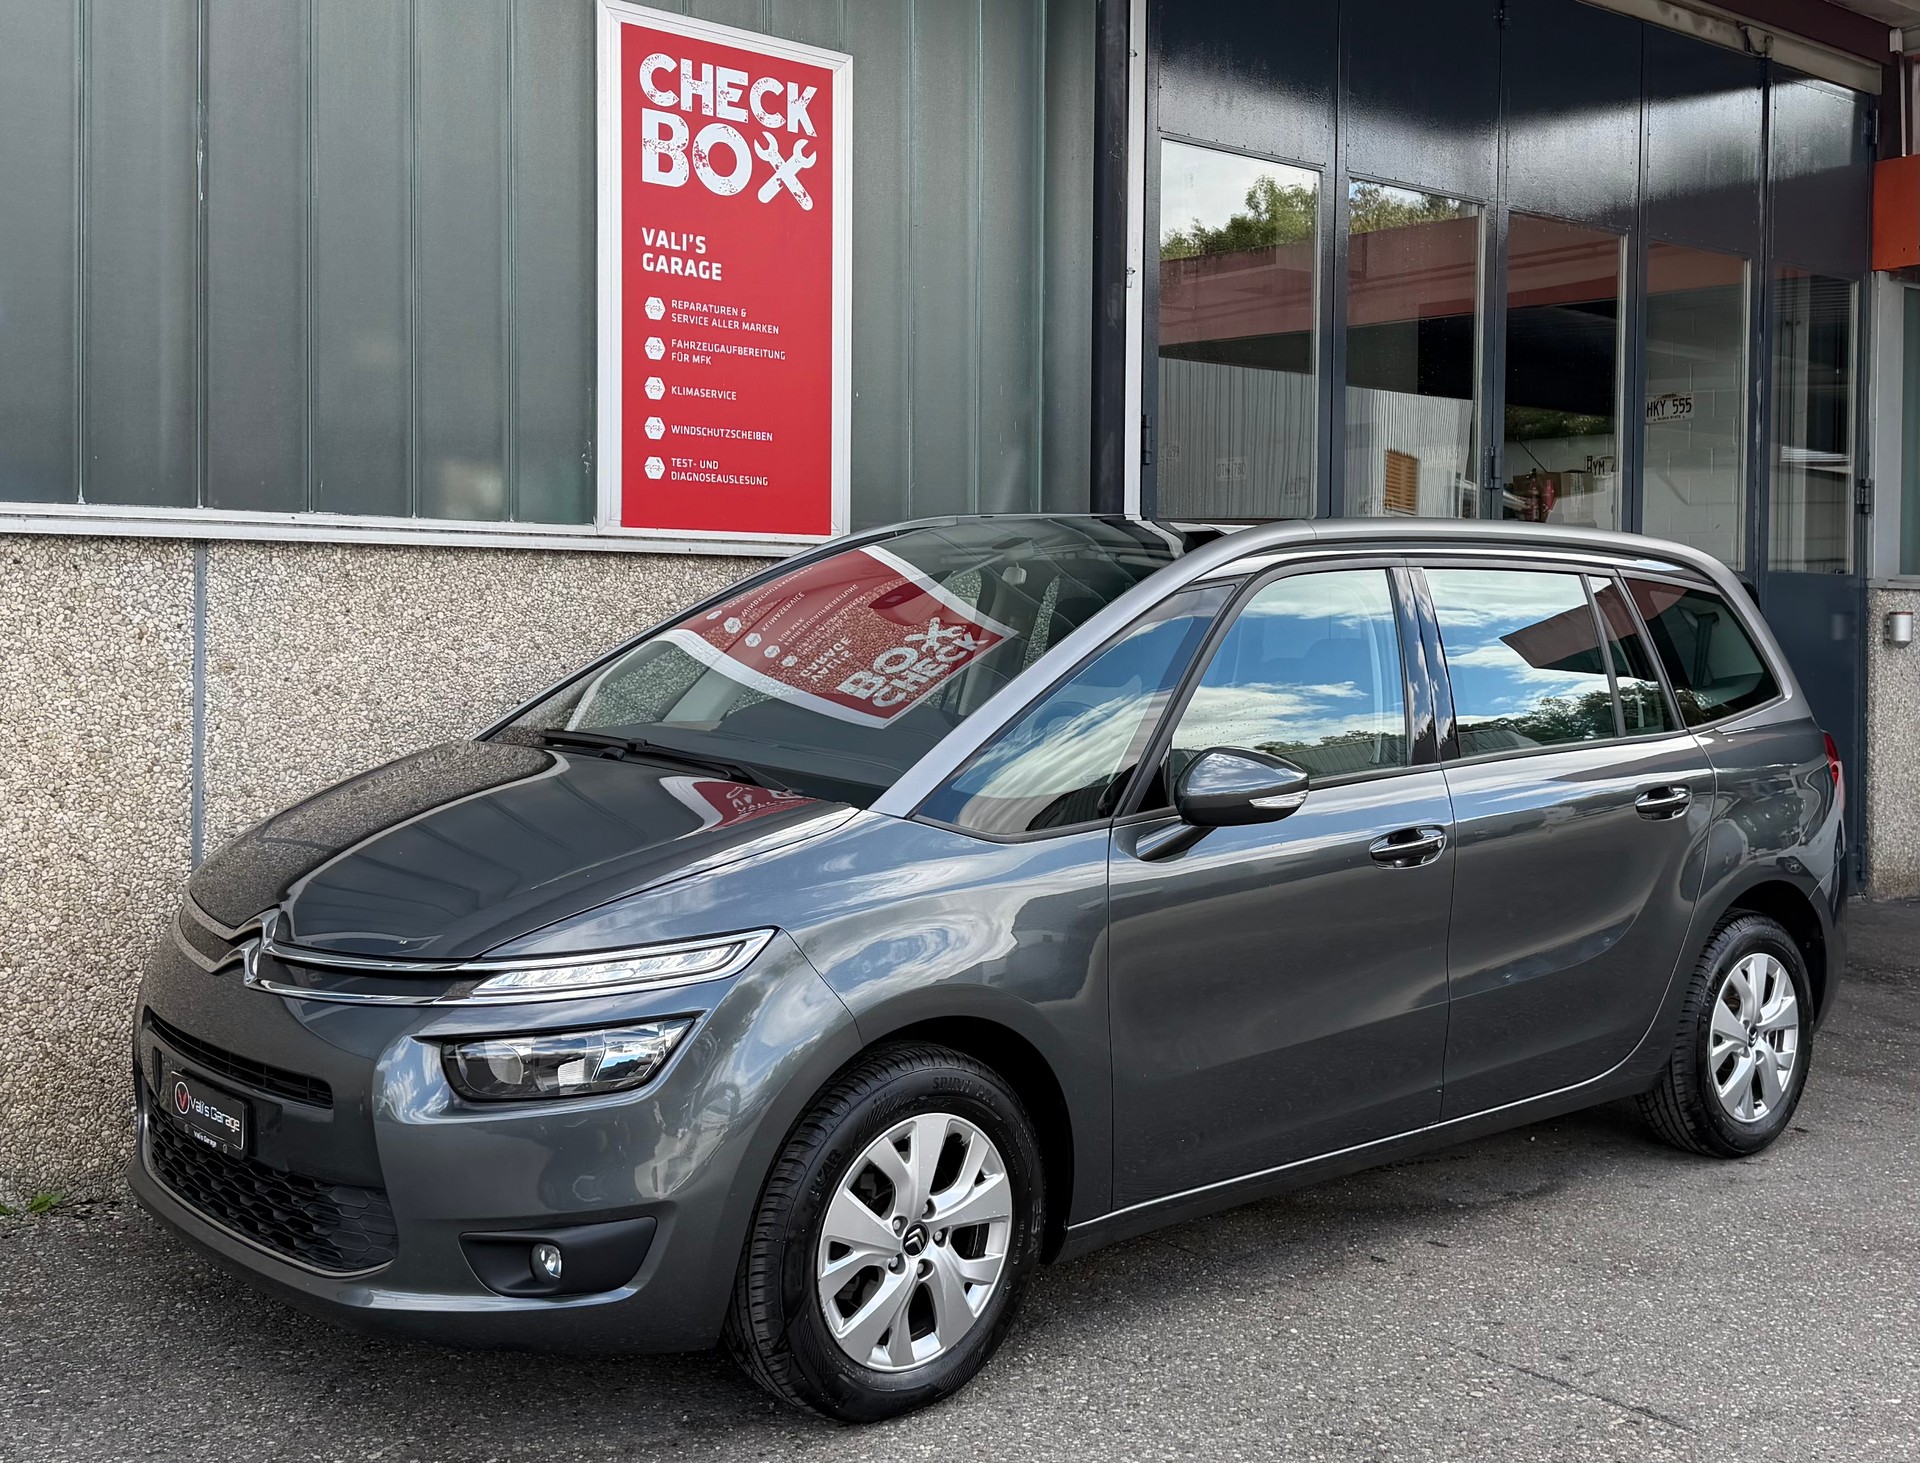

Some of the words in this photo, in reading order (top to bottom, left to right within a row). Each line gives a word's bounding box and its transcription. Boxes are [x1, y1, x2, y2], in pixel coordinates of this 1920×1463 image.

[639, 53, 818, 138] CHECK
[641, 107, 818, 211] BOX
[641, 227, 706, 254] VALI'S
[642, 253, 723, 282] GARAGE
[671, 299, 739, 317] REPARATUREN
[740, 308, 747, 318] &
[671, 312, 709, 326] SERVICE
[711, 318, 740, 330] ALLER
[742, 322, 780, 335] MARKEN
[671, 338, 786, 361] FAHRZEUGAUFBEREITUNG
[671, 351, 690, 363] FÜR
[692, 355, 712, 366] MFK
[671, 385, 737, 400] KLIMASERVICE
[1646, 399, 1667, 417] HKY
[1672, 397, 1692, 415] 555
[671, 424, 774, 442] WINDSCHUTZSCHEIBEN
[671, 457, 697, 468] TEST-
[699, 459, 719, 470] UND
[671, 471, 769, 486] DIAGNOSEAUSLESUNG
[210, 1106, 241, 1133] Garage
